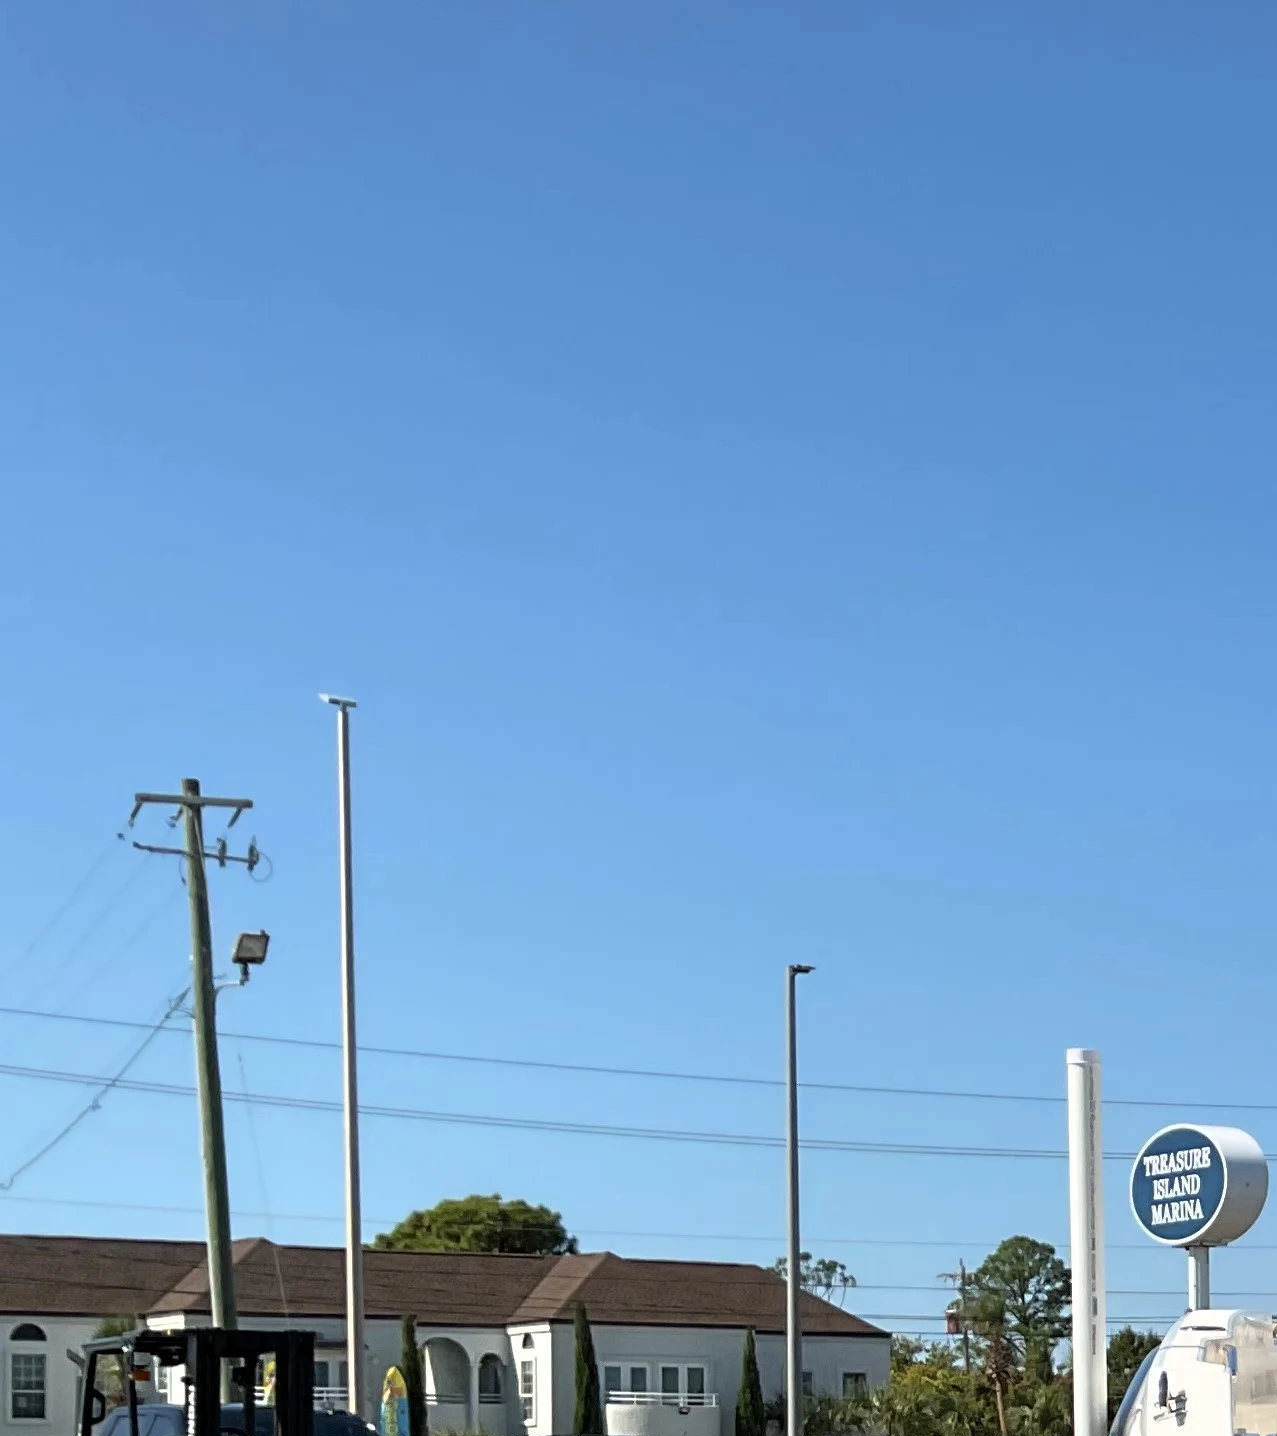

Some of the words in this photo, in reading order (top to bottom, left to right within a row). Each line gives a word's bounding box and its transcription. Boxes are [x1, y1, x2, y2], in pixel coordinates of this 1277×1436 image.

[1143, 1146, 1211, 1177] TREASURE
[1152, 1173, 1201, 1200] ISLAND
[1151, 1198, 1204, 1226] MARINA
